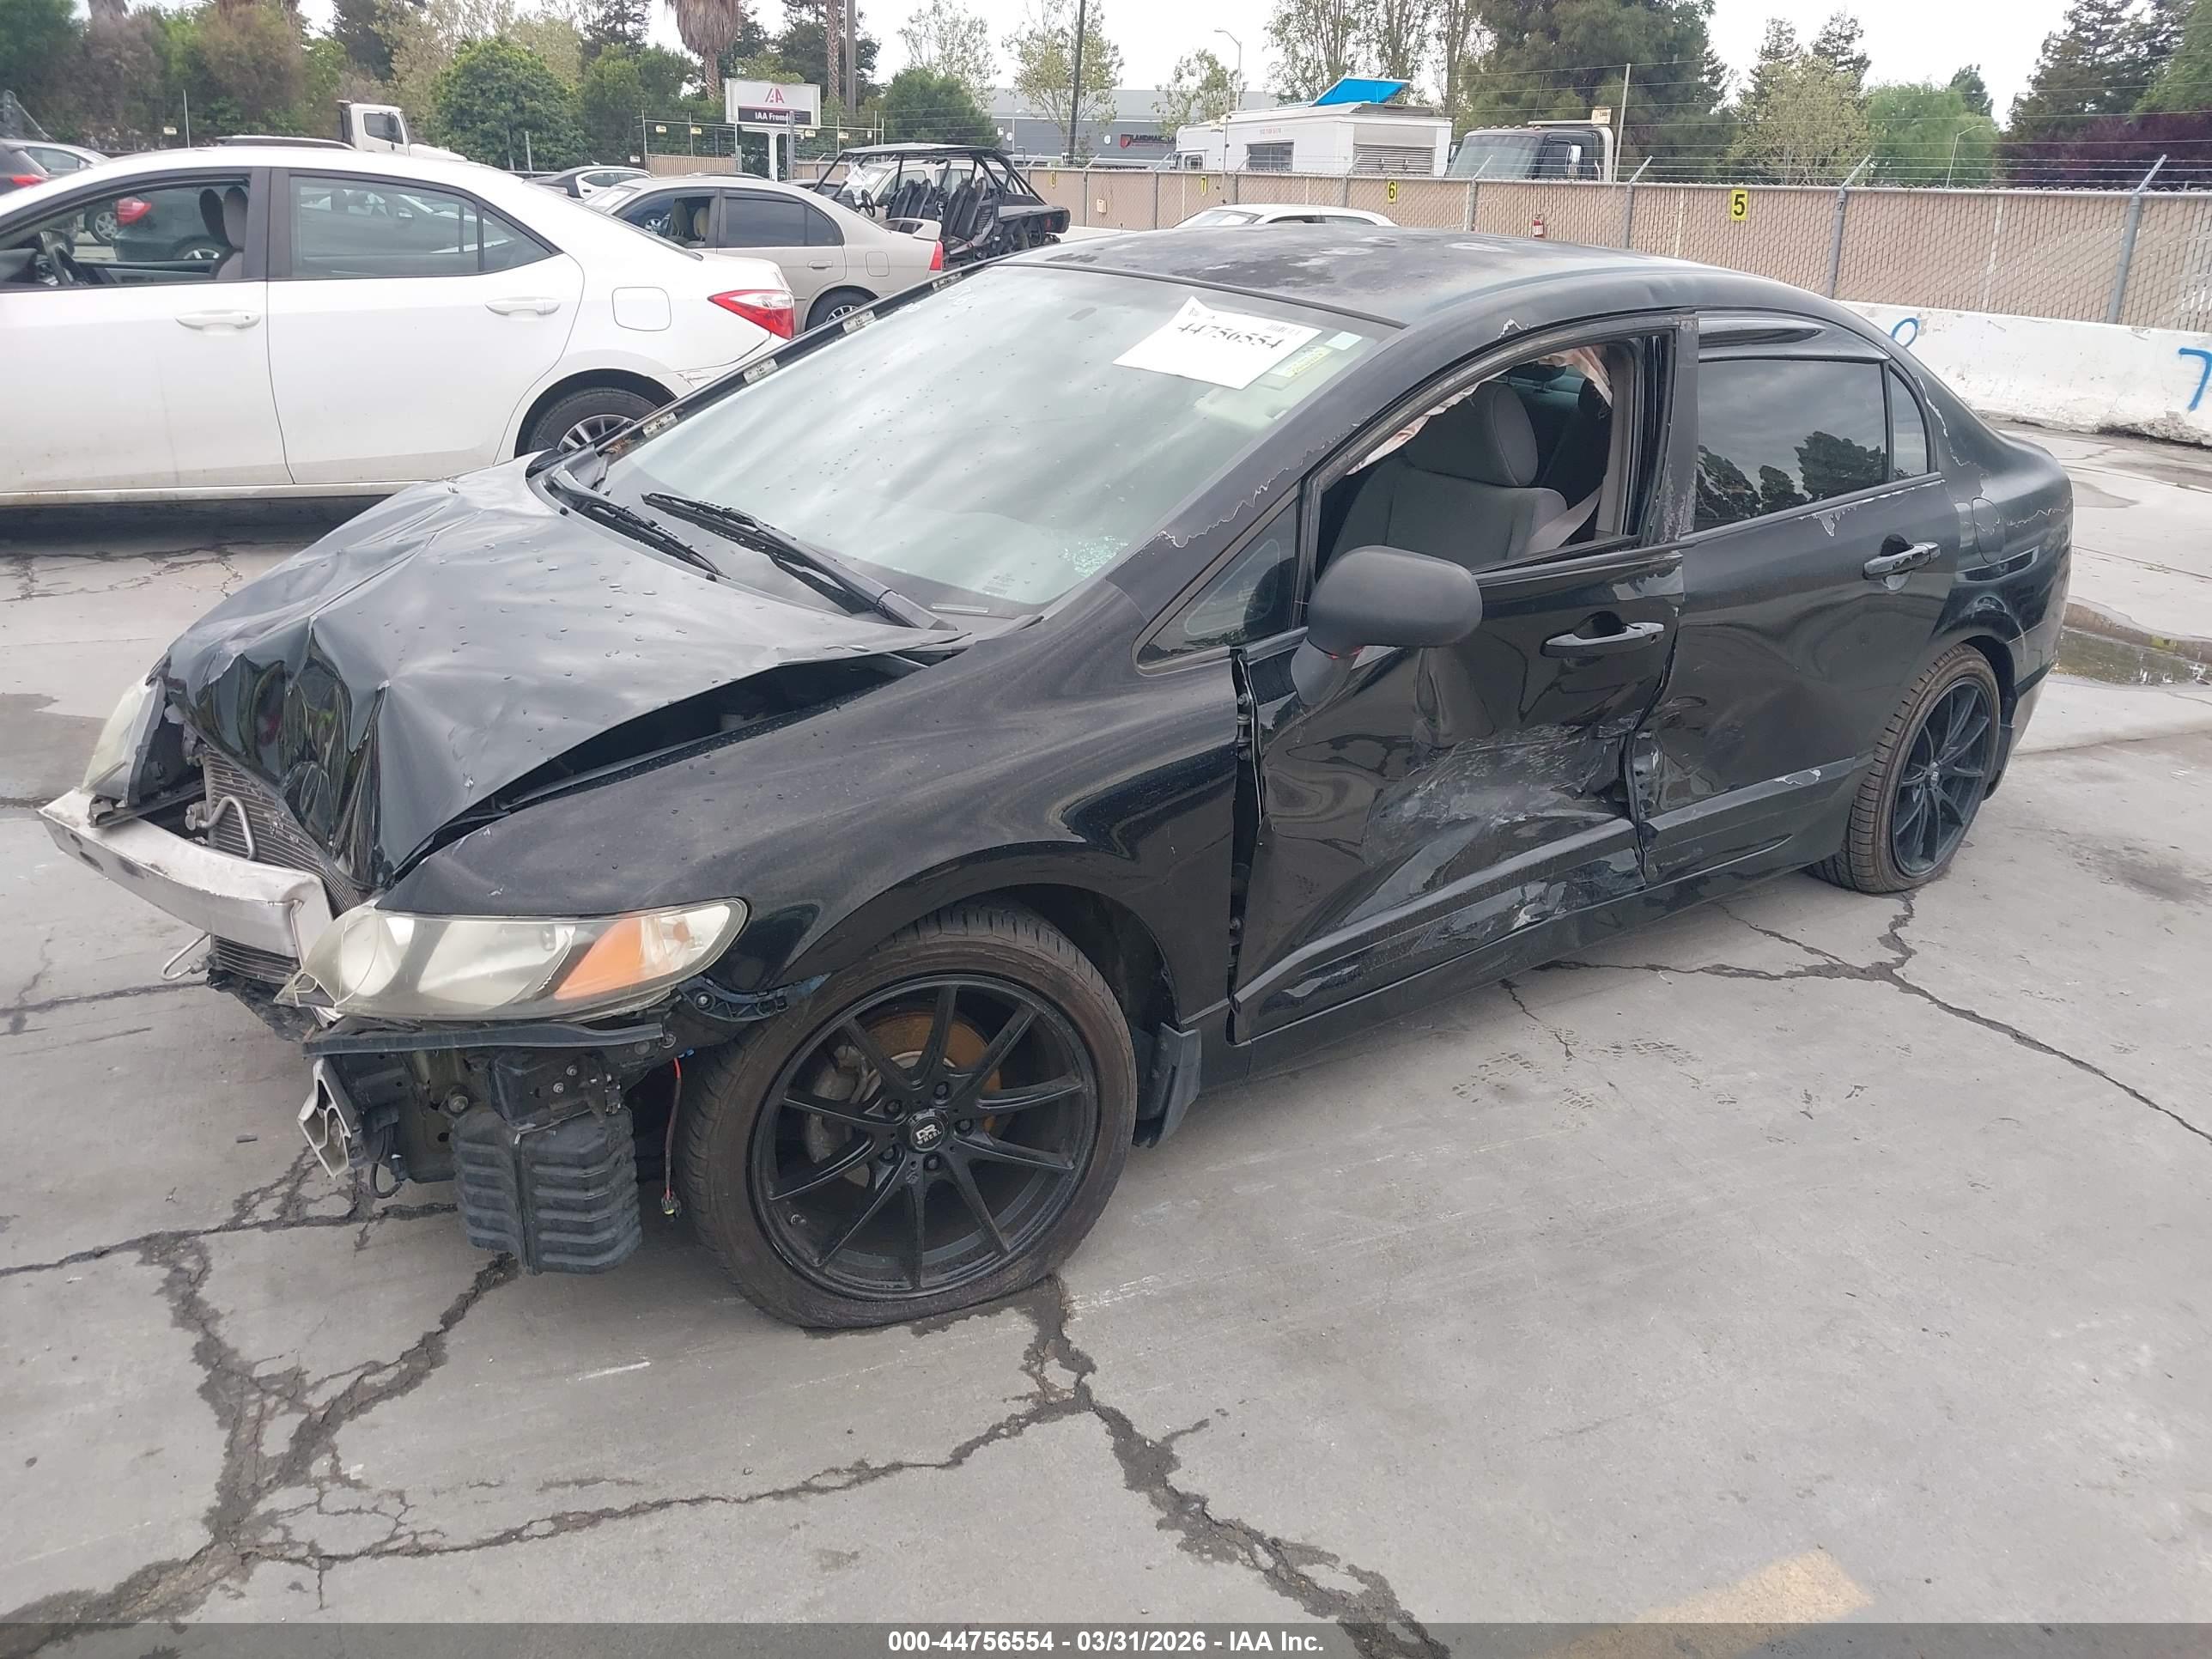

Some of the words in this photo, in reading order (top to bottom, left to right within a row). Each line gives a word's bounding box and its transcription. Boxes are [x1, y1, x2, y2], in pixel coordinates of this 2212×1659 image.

[756, 112, 768, 120] IAA
[769, 112, 791, 122] Fremo
[1389, 181, 1395, 199] 6
[1734, 194, 1746, 216] 5
[1177, 323, 1285, 349] 44756554
[2179, 346, 2212, 410] 7
